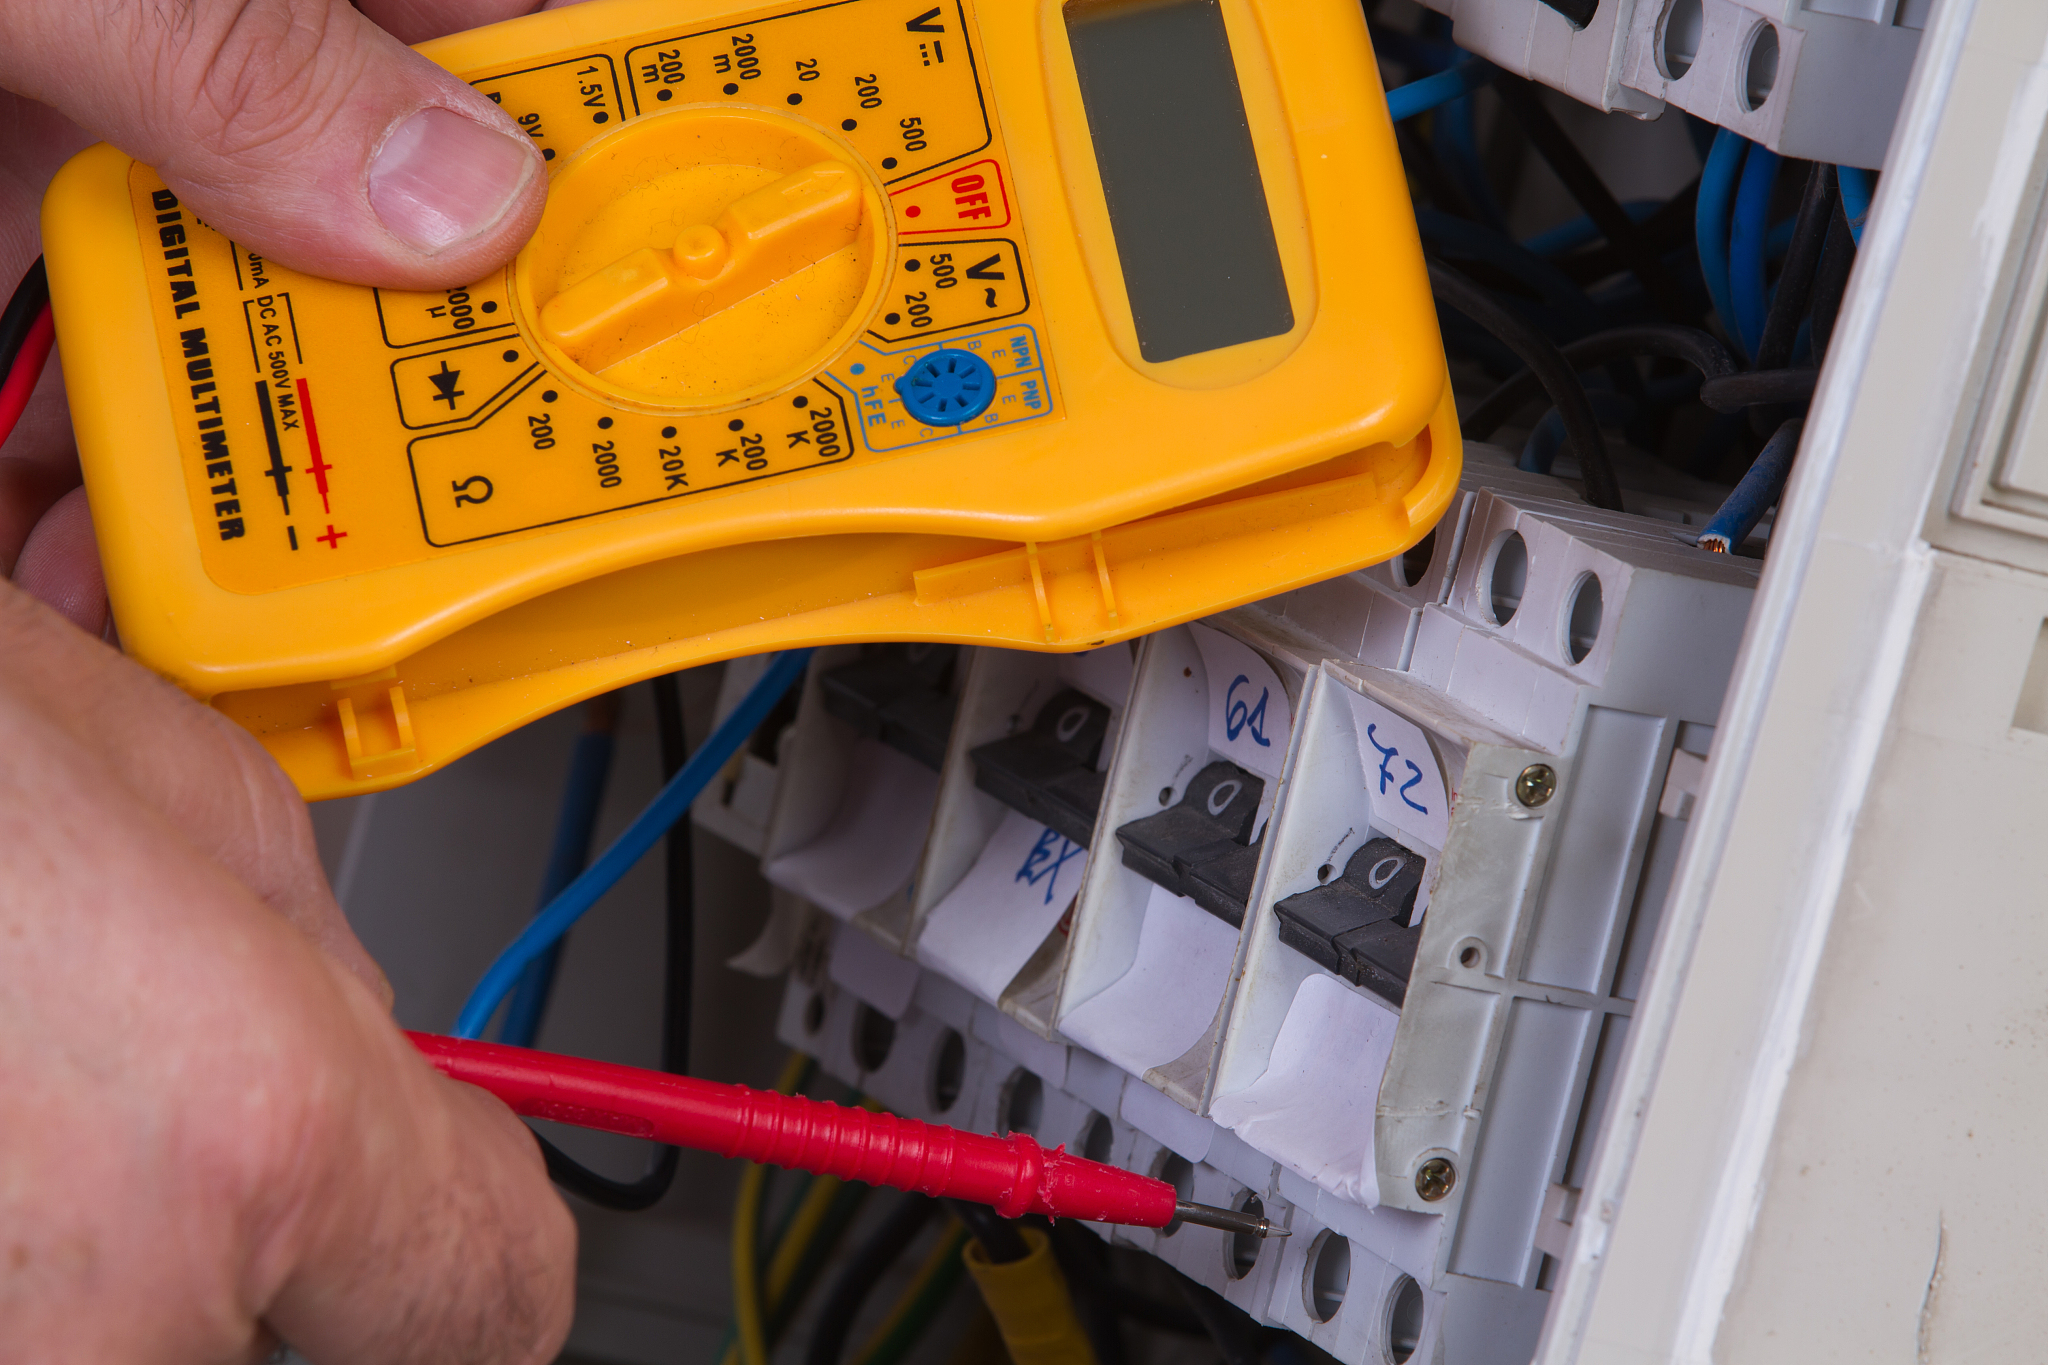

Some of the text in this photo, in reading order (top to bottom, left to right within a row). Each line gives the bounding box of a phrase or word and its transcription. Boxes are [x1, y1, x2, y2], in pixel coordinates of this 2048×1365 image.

[642, 64, 660, 84] m
[658, 49, 685, 84] 200
[713, 54, 732, 74] m
[732, 33, 761, 80] 2000
[796, 58, 820, 82] 20
[576, 65, 605, 107] 1.5V
[854, 74, 882, 108] 200
[518, 113, 544, 137] 9V
[900, 116, 927, 152] 500
[951, 174, 992, 220] OFF
[930, 253, 958, 288] 500
[446, 286, 475, 329] 000
[904, 292, 932, 328] 200
[968, 340, 982, 350] B
[992, 349, 1006, 359] E
[1010, 335, 1032, 368] NPN
[152, 189, 245, 541] DIGITAL MULTIMETER
[256, 295, 300, 431] DC AC 500V MAX
[881, 373, 895, 382] E
[861, 385, 886, 427] hFE
[1002, 394, 1016, 405] E
[1020, 379, 1042, 410] PNP
[528, 413, 556, 450] 200
[810, 407, 840, 457] 2000
[891, 419, 905, 429] E
[920, 428, 933, 437] C
[984, 413, 998, 424] B
[740, 434, 768, 470] 200
[786, 430, 810, 448] K
[592, 440, 622, 488] 2000
[659, 446, 688, 491] 20K
[716, 448, 740, 468] K
[1225, 674, 1271, 748] 61
[1367, 723, 1428, 815] 72
